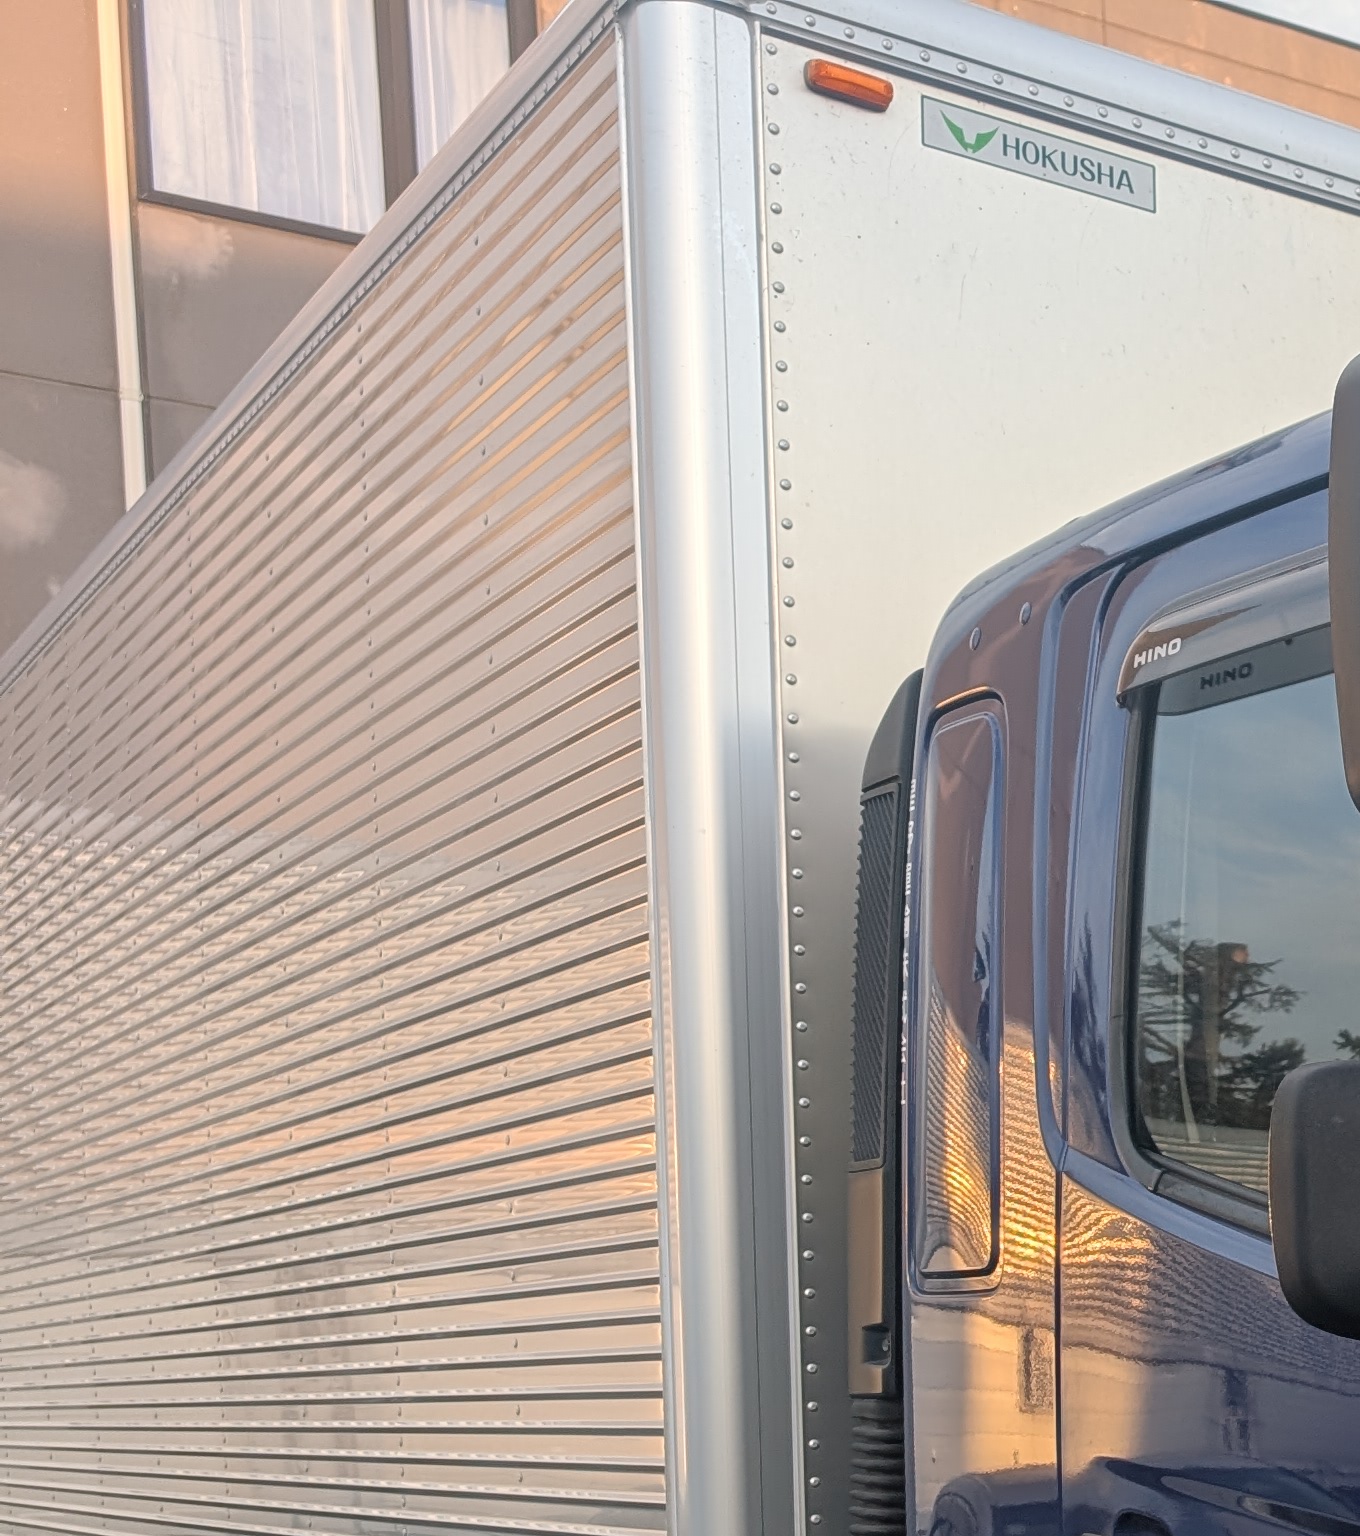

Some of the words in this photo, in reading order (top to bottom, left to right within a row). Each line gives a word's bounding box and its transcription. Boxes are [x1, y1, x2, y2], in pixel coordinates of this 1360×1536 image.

[1001, 133, 1135, 195] HOKUSHA
[1133, 637, 1182, 668] HINO
[1199, 662, 1253, 689] HINO
